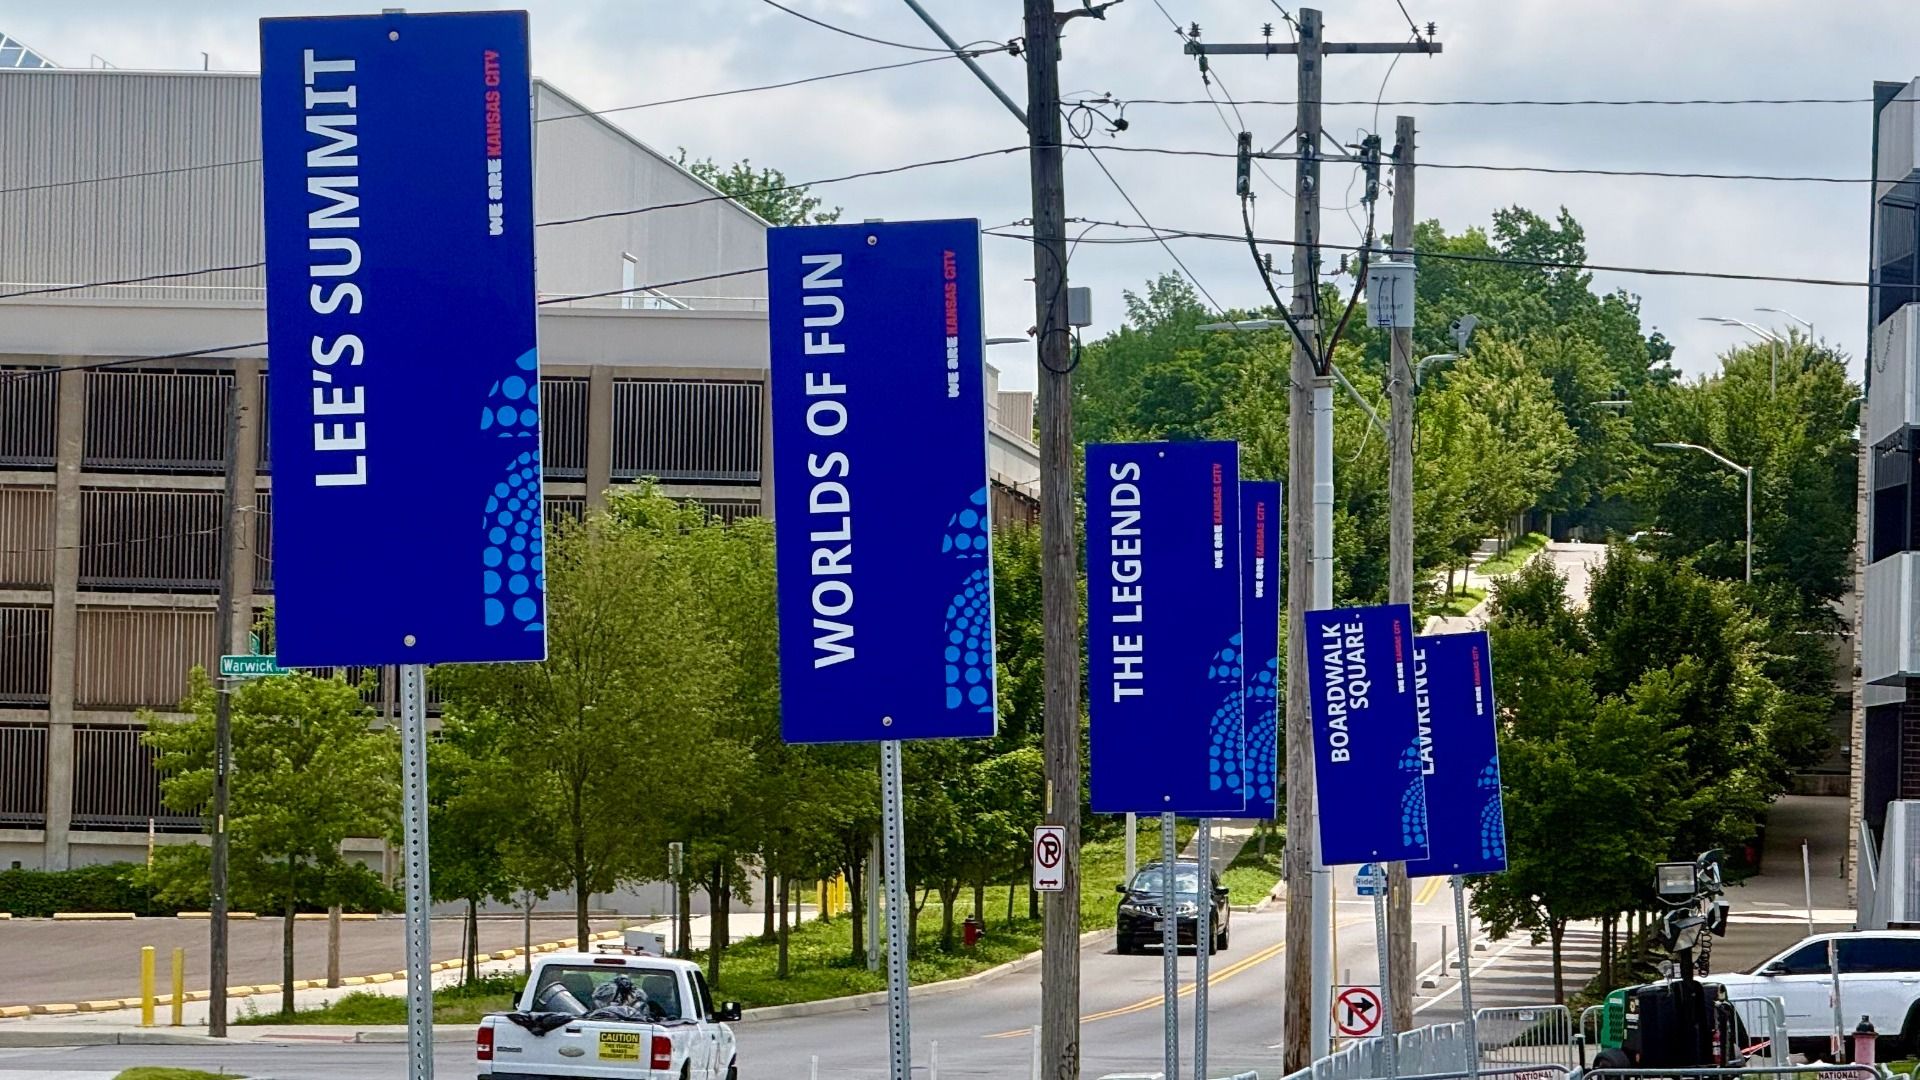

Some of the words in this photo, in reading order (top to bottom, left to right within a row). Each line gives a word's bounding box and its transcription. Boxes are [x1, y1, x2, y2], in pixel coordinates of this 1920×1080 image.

[484, 50, 501, 87] CITY
[485, 91, 502, 157] KANSAS
[303, 49, 364, 315] SUMMIT
[487, 159, 503, 200] ARE
[488, 202, 504, 236] WE
[943, 250, 957, 280] CITY
[801, 253, 846, 355] FUN
[944, 281, 958, 336] KANSAS
[946, 336, 959, 370] ARE
[947, 371, 960, 398] WE
[311, 334, 367, 487] LEE'S
[805, 373, 848, 436] OF
[1212, 463, 1222, 484] CITY
[1212, 485, 1223, 524] KANSAS
[807, 451, 855, 669] WORLDS
[1109, 462, 1142, 623] LEGENDS
[1214, 549, 1224, 569] WE
[1255, 580, 1265, 598] WE
[223, 659, 273, 672] Warwick
[1112, 634, 1144, 703] THE
[1344, 622, 1371, 709] SQUARE
[1321, 623, 1350, 763] BOARDWALK
[601, 1033, 639, 1043] CAUTION
[1515, 1071, 1553, 1080] NATIONAL
[1818, 1071, 1858, 1079] NATIONAL
